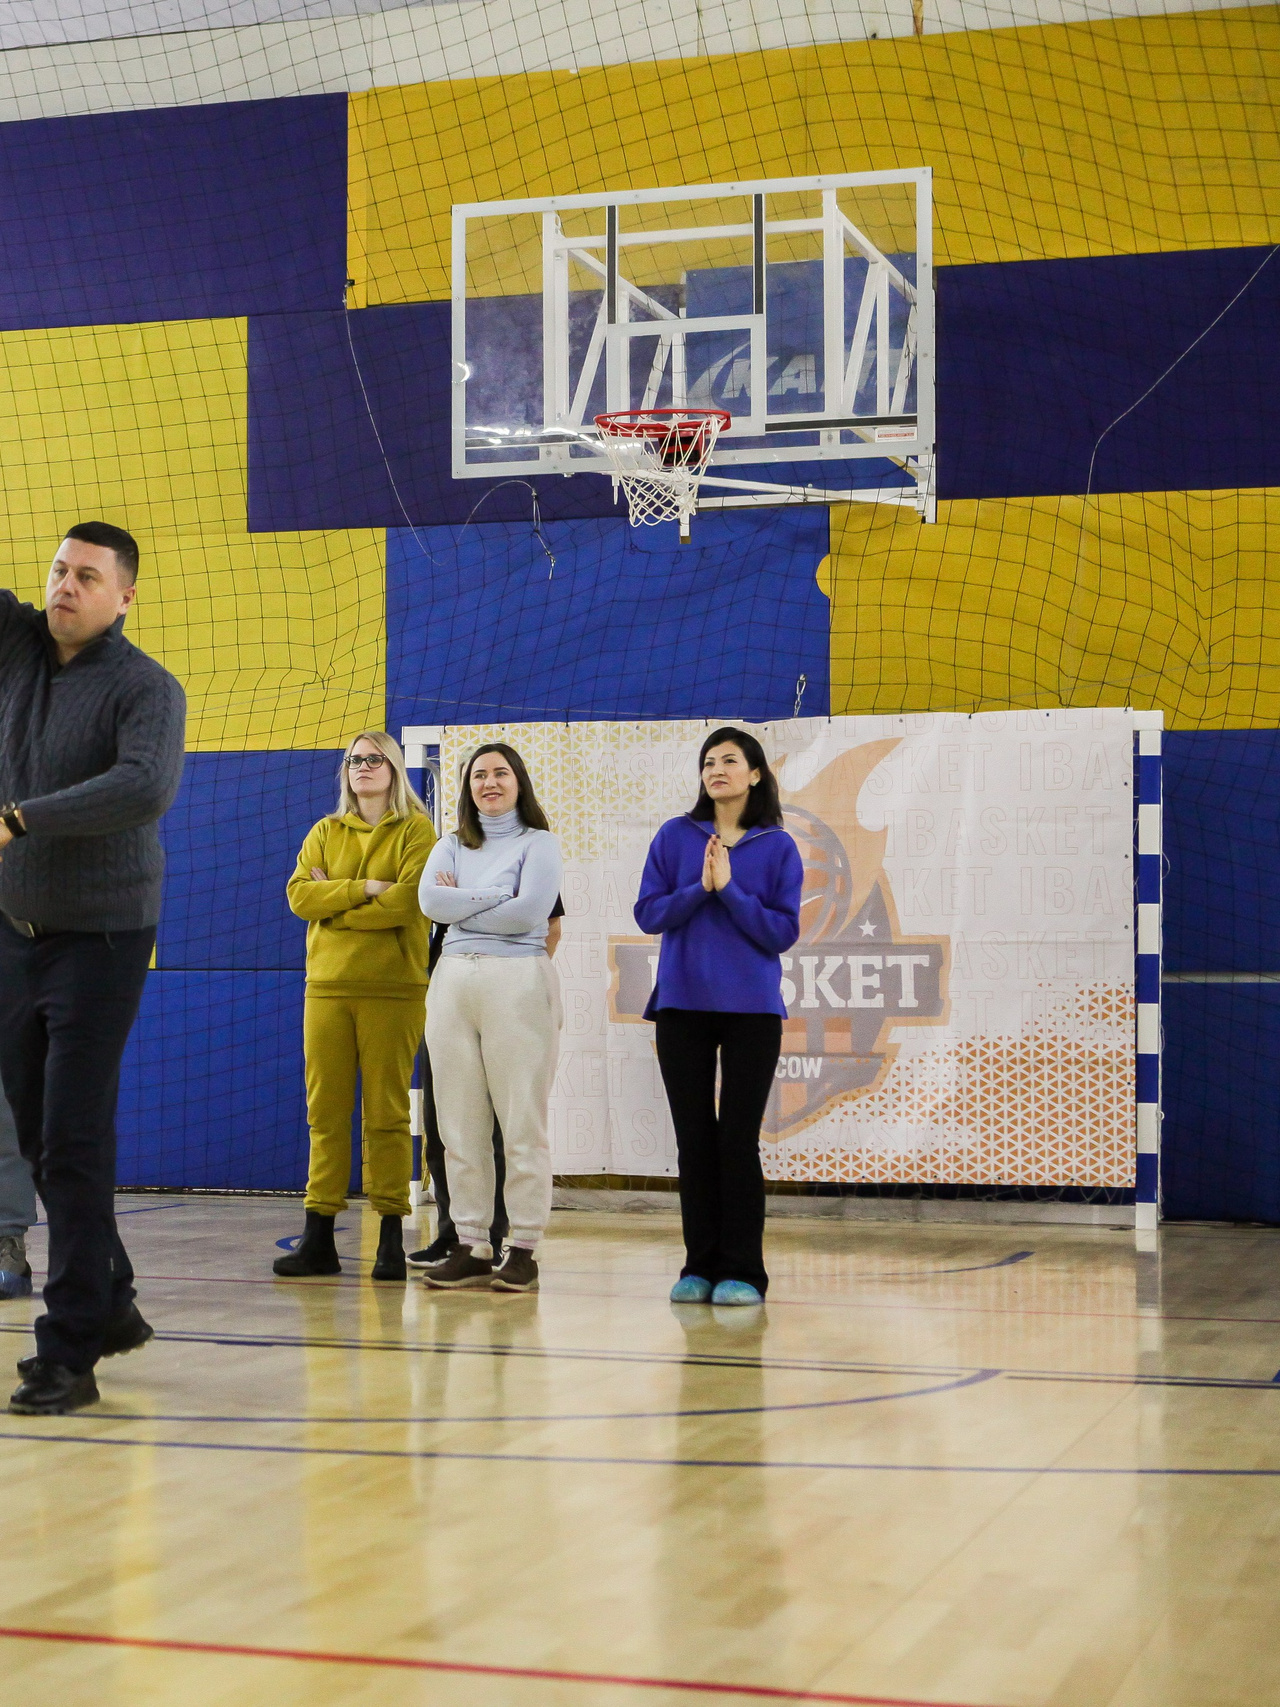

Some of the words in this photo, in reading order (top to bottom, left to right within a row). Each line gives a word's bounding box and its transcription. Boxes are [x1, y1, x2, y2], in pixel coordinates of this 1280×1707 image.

[540, 751, 694, 800] IBASK
[883, 806, 1112, 858] IBASKET
[647, 954, 930, 1009] ISKET
[774, 1056, 823, 1079] COW
